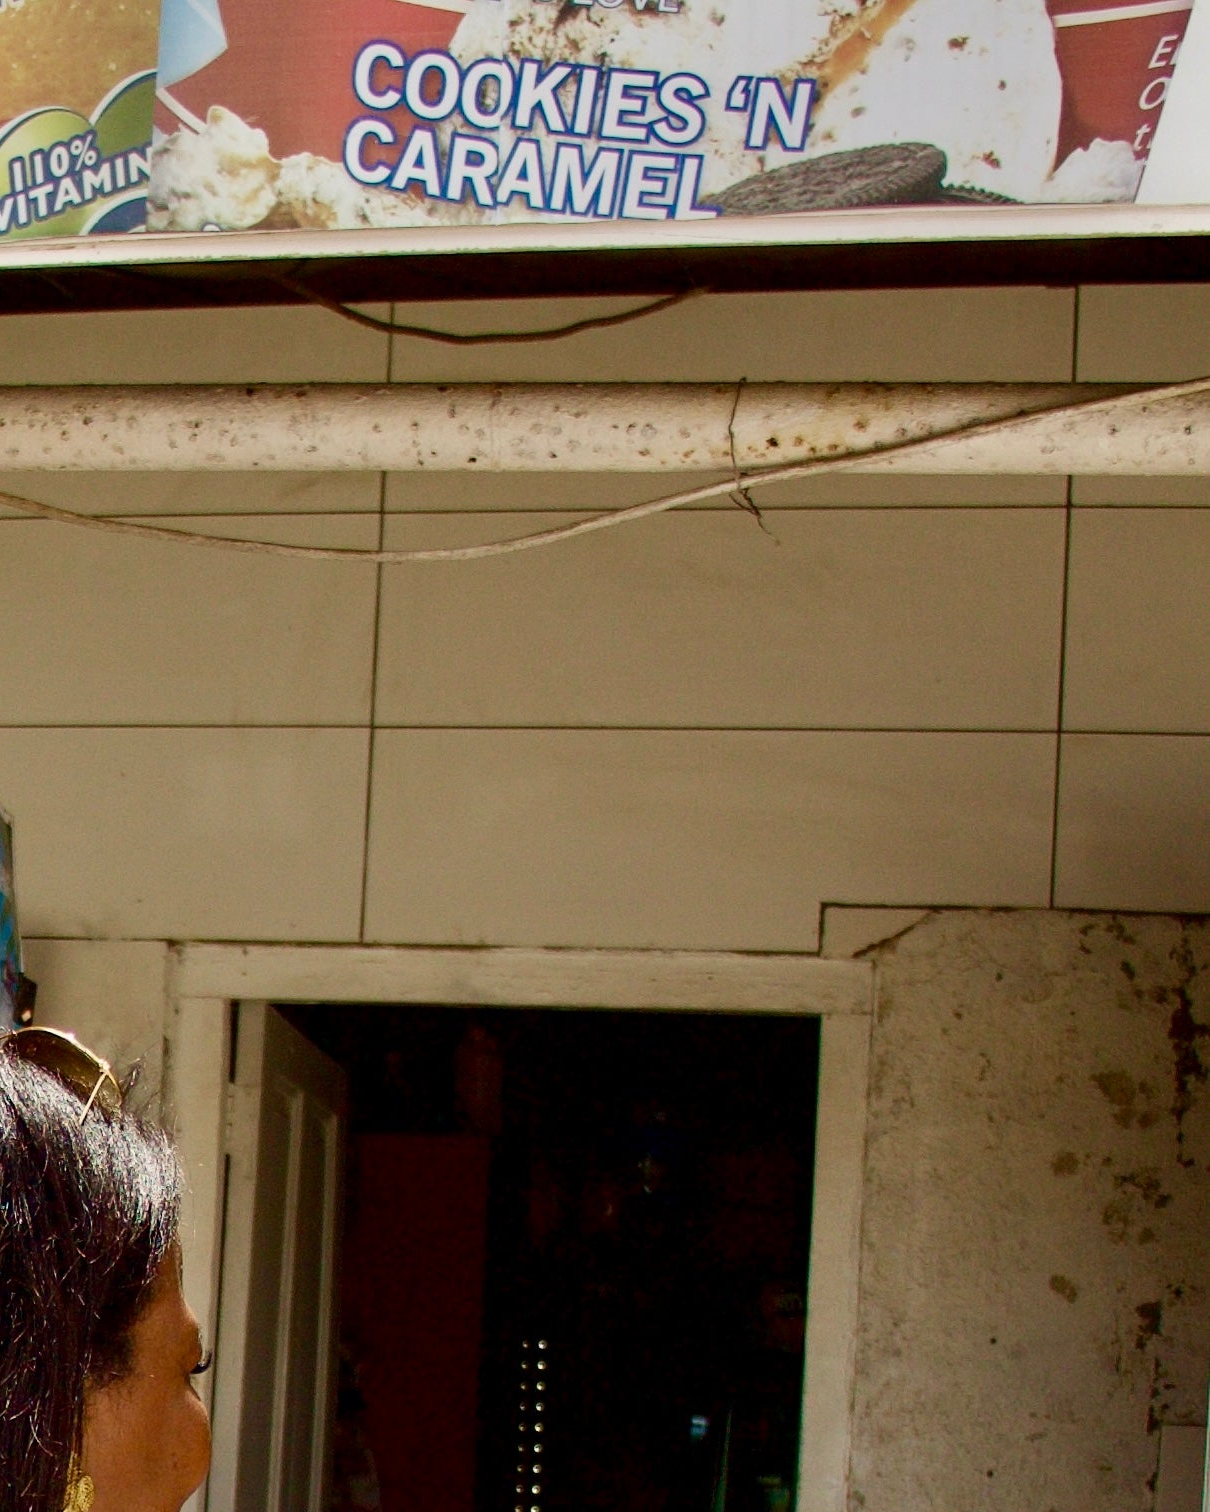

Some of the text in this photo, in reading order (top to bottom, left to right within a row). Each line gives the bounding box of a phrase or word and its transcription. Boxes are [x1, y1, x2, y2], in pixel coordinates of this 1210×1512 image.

[353, 41, 710, 145] COOKIES
[9, 132, 98, 194] 110%
[343, 116, 722, 219] CARAMEL
